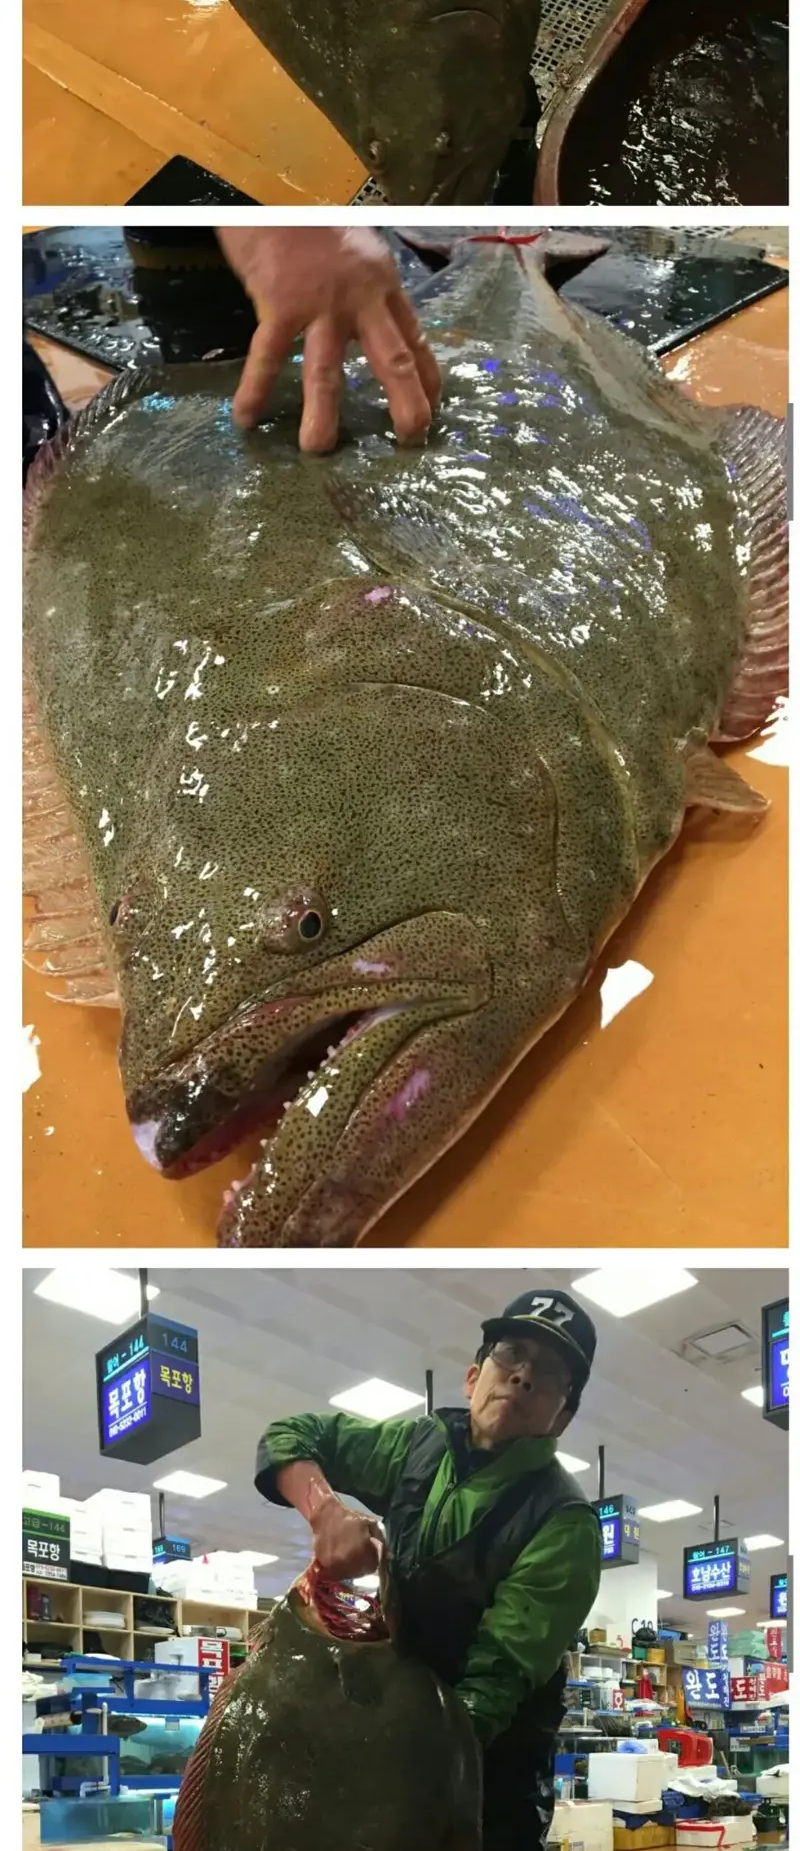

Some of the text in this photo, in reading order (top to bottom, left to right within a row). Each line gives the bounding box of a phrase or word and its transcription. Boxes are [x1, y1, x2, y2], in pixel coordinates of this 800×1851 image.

[529, 1296, 575, 1326] 77
[129, 1334, 144, 1355] 144
[162, 1333, 188, 1353] 144
[160, 1365, 193, 1394] 목포항
[108, 1368, 146, 1419] 목포항
[602, 1524, 615, 1545] 원
[27, 1539, 61, 1562] 목포항
[716, 1546, 730, 1554] 147
[691, 1561, 732, 1583] 호남수산
[686, 1670, 720, 1701] 완도
